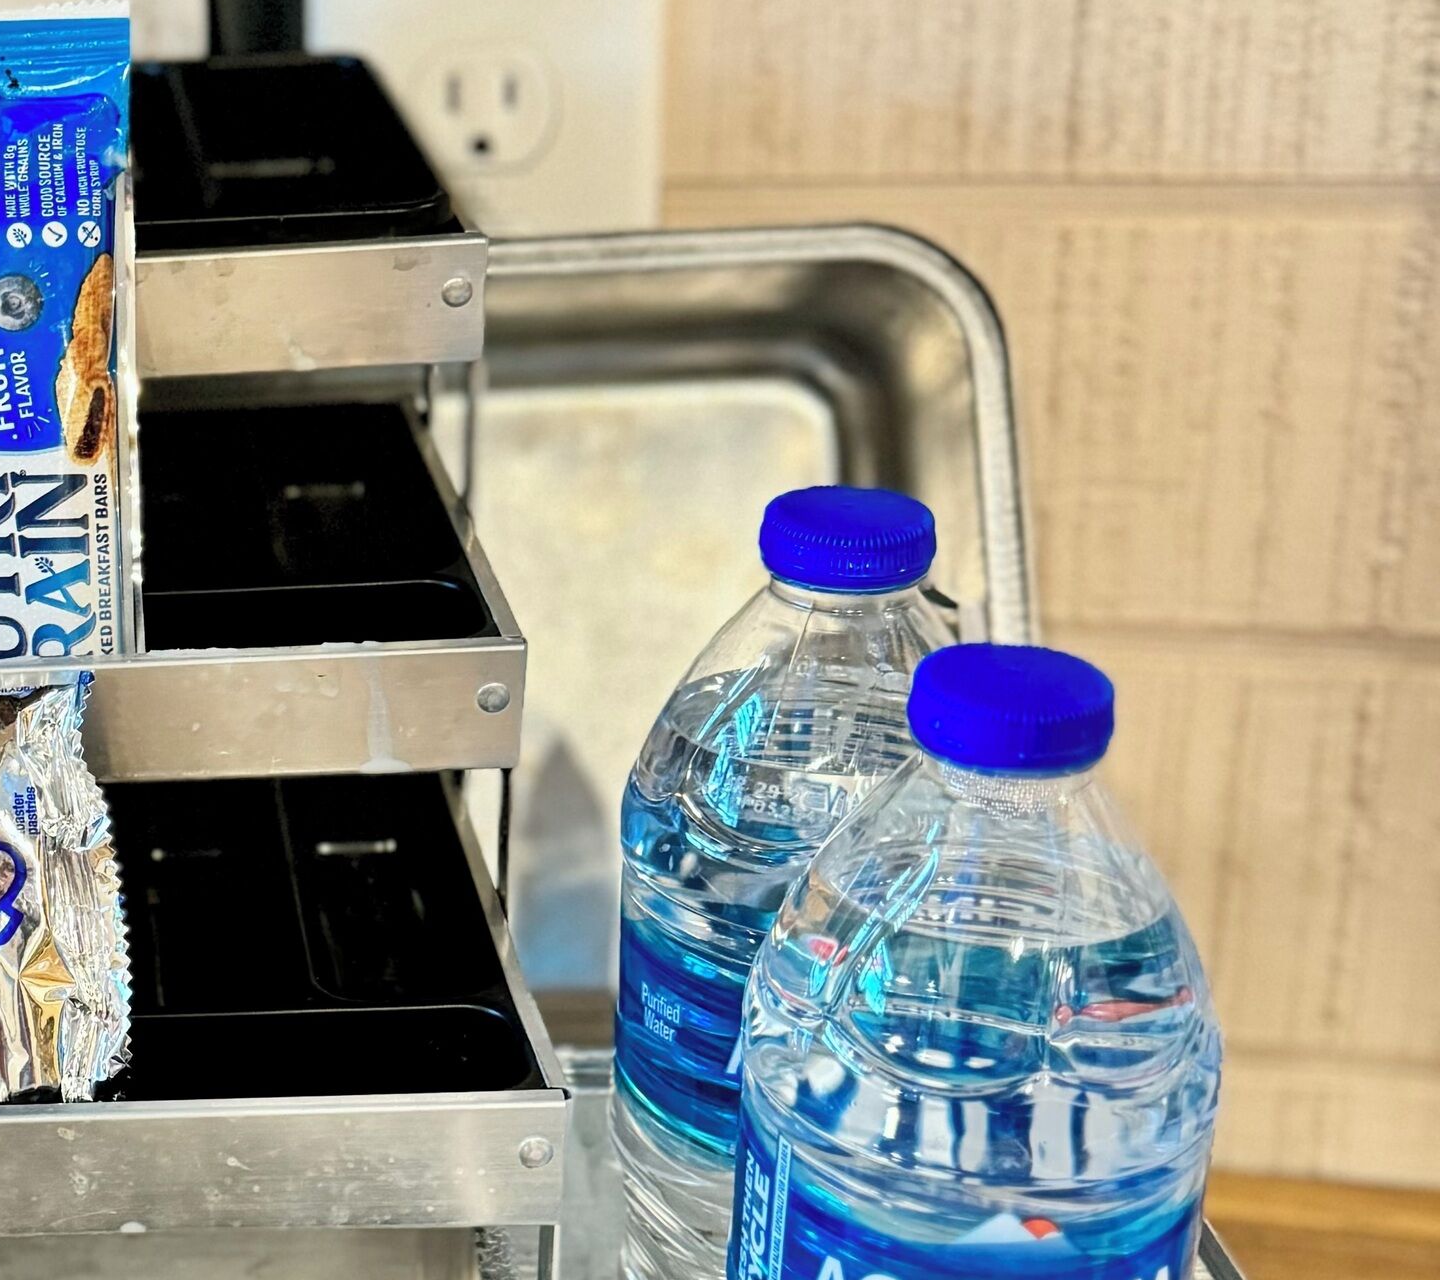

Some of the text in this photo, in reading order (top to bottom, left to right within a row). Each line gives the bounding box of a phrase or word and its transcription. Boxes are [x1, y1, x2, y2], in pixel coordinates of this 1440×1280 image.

[3, 145, 17, 160] 8g
[51, 124, 64, 150] IRON
[17, 138, 30, 217] WHOLE GRAINS
[38, 134, 55, 217] GOOD SOURCE
[53, 164, 66, 203] CALCIUM
[76, 127, 90, 216] NO HIGH FRUCTOSE
[89, 160, 101, 217] CORN SYRUP
[5, 194, 17, 218] MADE
[57, 206, 67, 217] OF
[8, 350, 34, 419] FLAVOR
[93, 473, 109, 519] BARS
[95, 523, 113, 621] BREAKFAST
[25, 786, 41, 835] pastries
[640, 980, 681, 1024] Purified
[644, 1006, 676, 1042] Water
[742, 1149, 755, 1223] THEN
